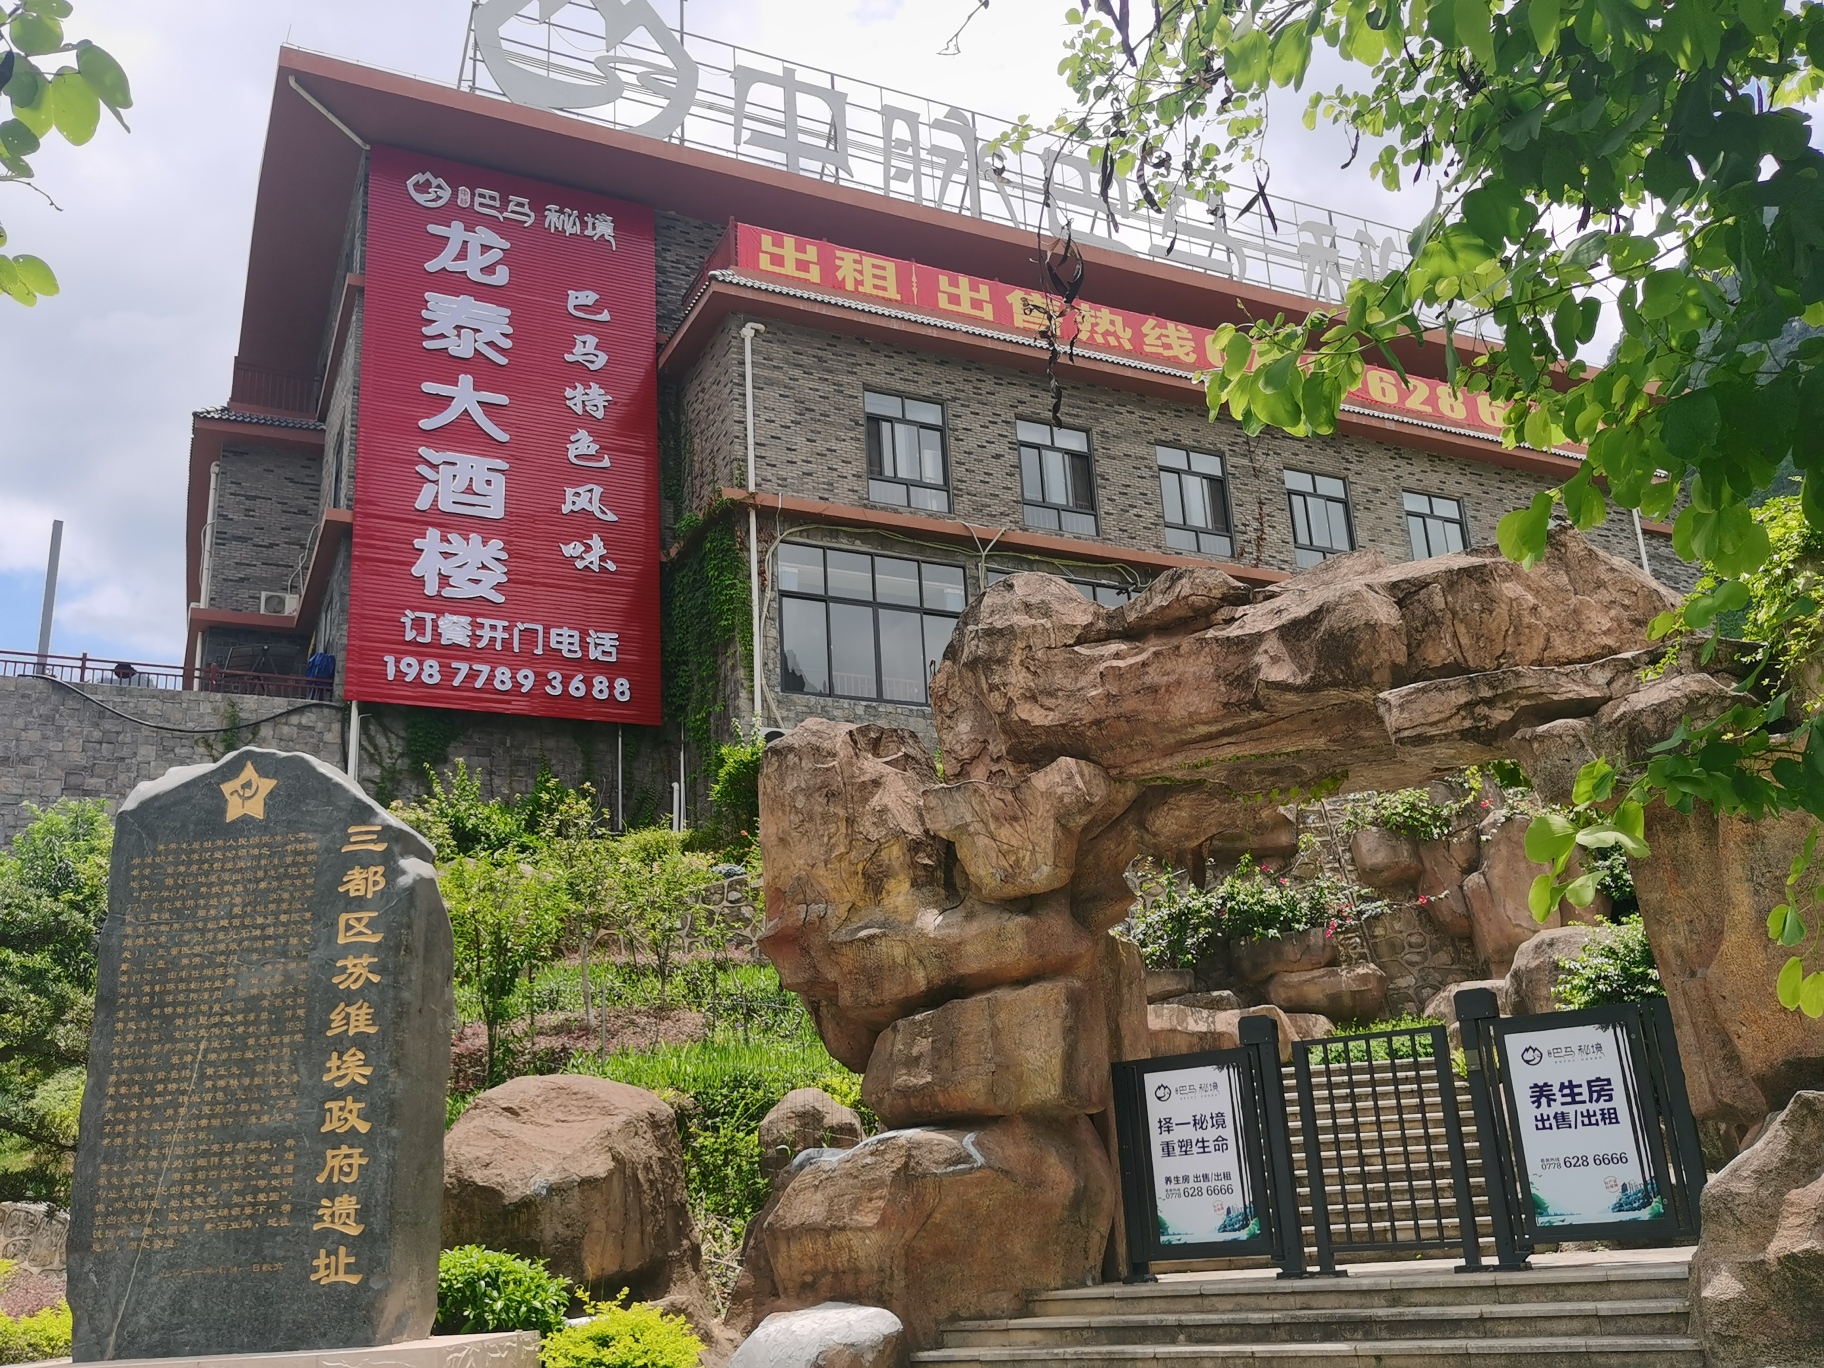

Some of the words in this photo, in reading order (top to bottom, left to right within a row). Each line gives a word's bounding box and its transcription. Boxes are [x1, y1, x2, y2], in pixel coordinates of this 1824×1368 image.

[411, 220, 513, 604] 龙泰大酒楼
[560, 289, 618, 573] 巴马特色风味
[400, 609, 620, 662] 订餐开门电话
[310, 825, 389, 1286] 三都区苏维埃政府遗址
[1529, 1076, 1615, 1110] 养生房
[1157, 1111, 1227, 1136] 择一秘境
[1534, 1107, 1620, 1132] 出售/出租
[1160, 1135, 1229, 1158] 重塑生命
[1563, 1155, 1589, 1168] 628
[1593, 1152, 1628, 1166] 6666
[1164, 1173, 1190, 1186] 养生房
[1193, 1171, 1232, 1183] 出售/出租
[1183, 1186, 1203, 1198] 628
[1206, 1184, 1234, 1196] 6666
